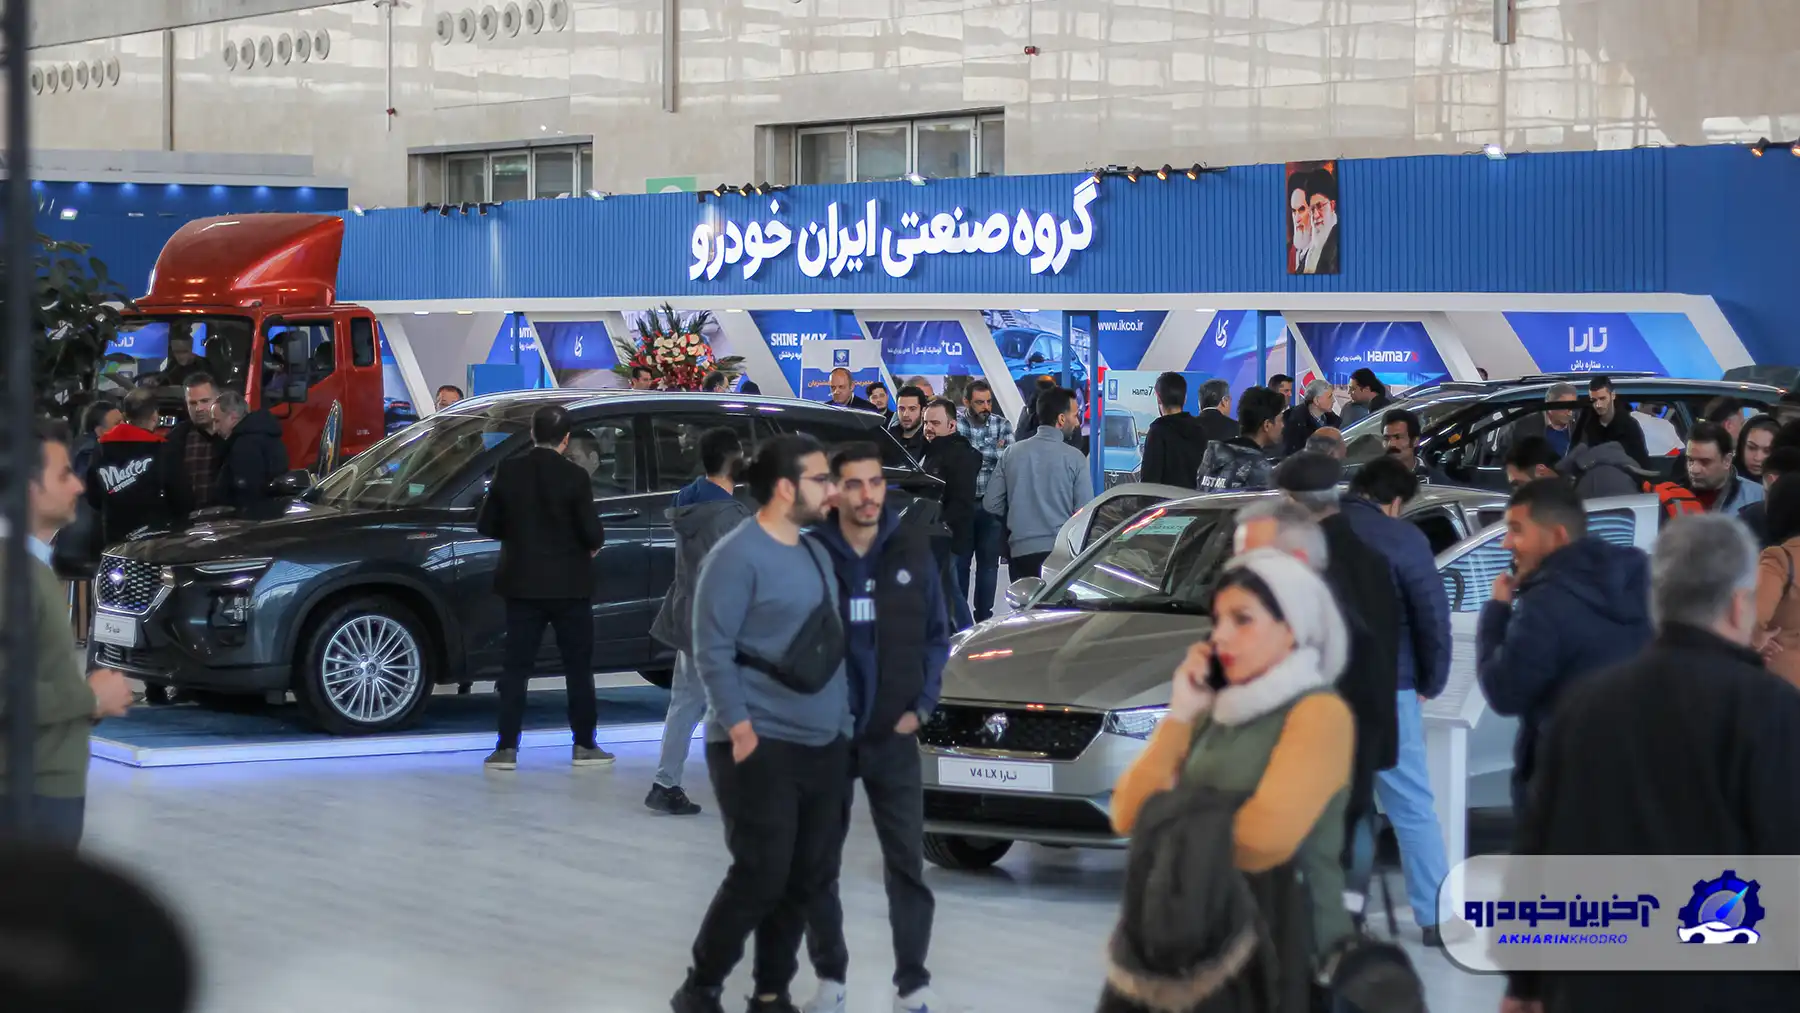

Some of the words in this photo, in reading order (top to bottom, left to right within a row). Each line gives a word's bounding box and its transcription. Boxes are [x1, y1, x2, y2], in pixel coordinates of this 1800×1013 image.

[797, 198, 877, 278] ایران
[1012, 175, 1097, 275] گروه
[689, 199, 793, 280] خودرو
[881, 206, 1010, 278] صنعتی
[1098, 319, 1144, 331] www.ikco.ir
[771, 333, 798, 346] SHINE
[1569, 326, 1608, 353] تارا
[99, 457, 152, 490] Master
[970, 768, 982, 778] V4
[985, 769, 997, 779] LX
[1000, 769, 1018, 782] تارا
